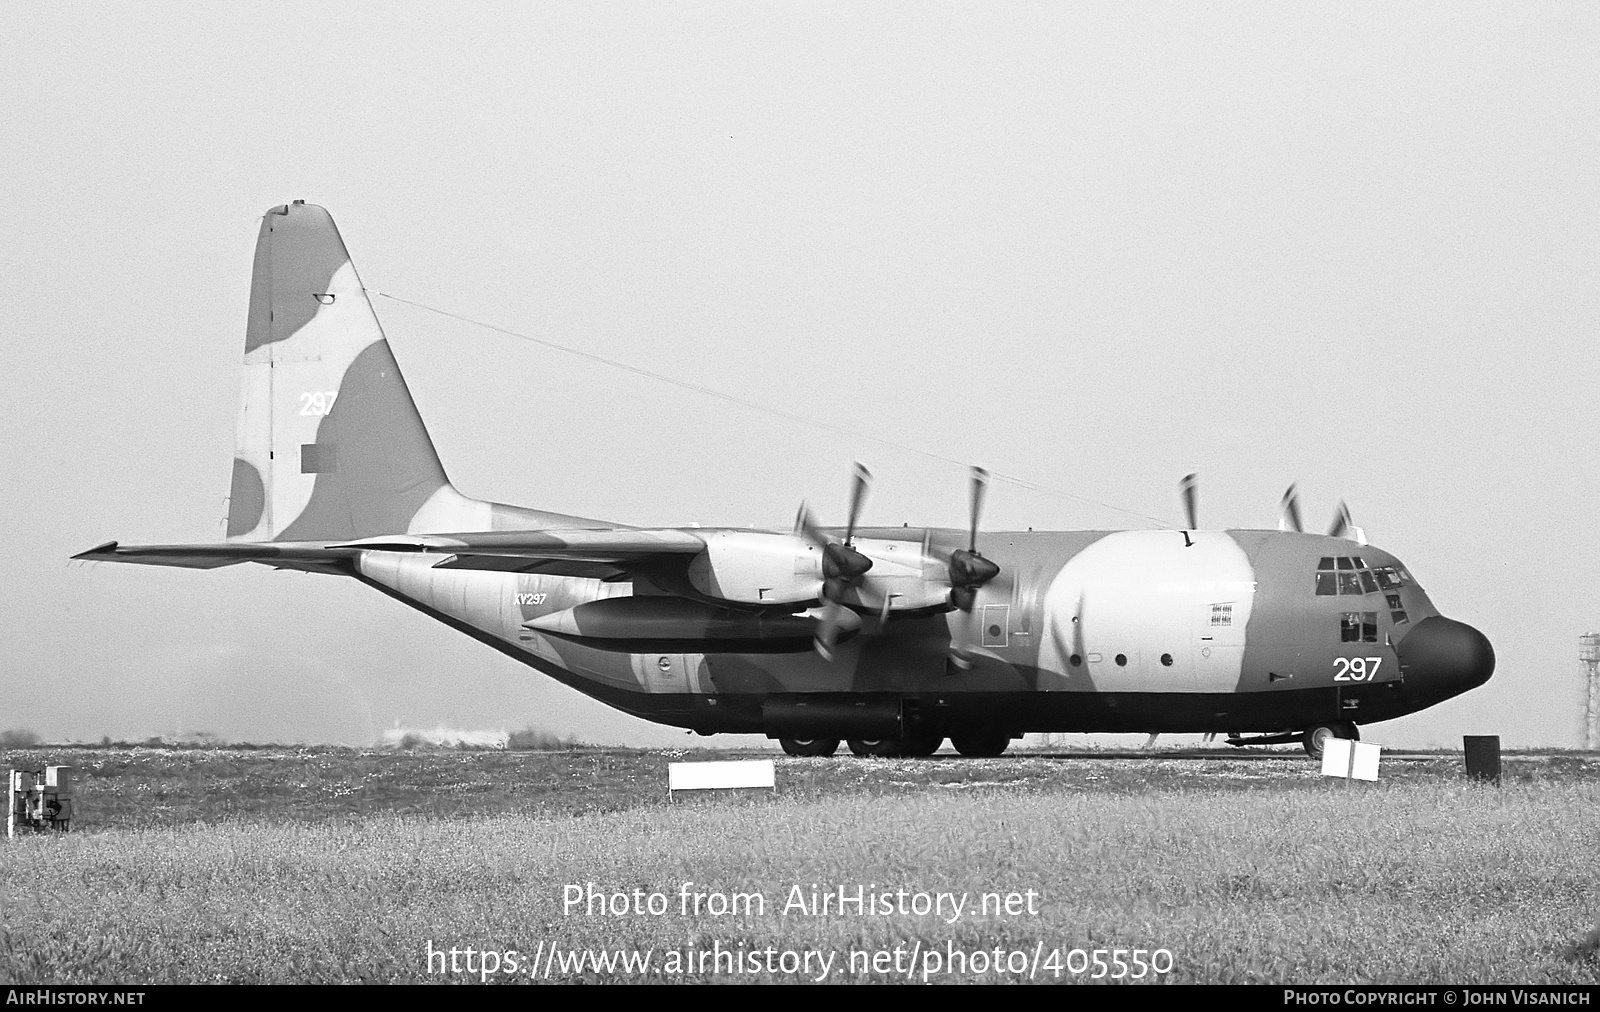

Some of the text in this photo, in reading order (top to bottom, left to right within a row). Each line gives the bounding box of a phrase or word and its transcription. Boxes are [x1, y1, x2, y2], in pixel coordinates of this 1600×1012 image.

[299, 390, 338, 416] 297
[514, 593, 547, 605] XV297
[1333, 657, 1382, 682] 297
